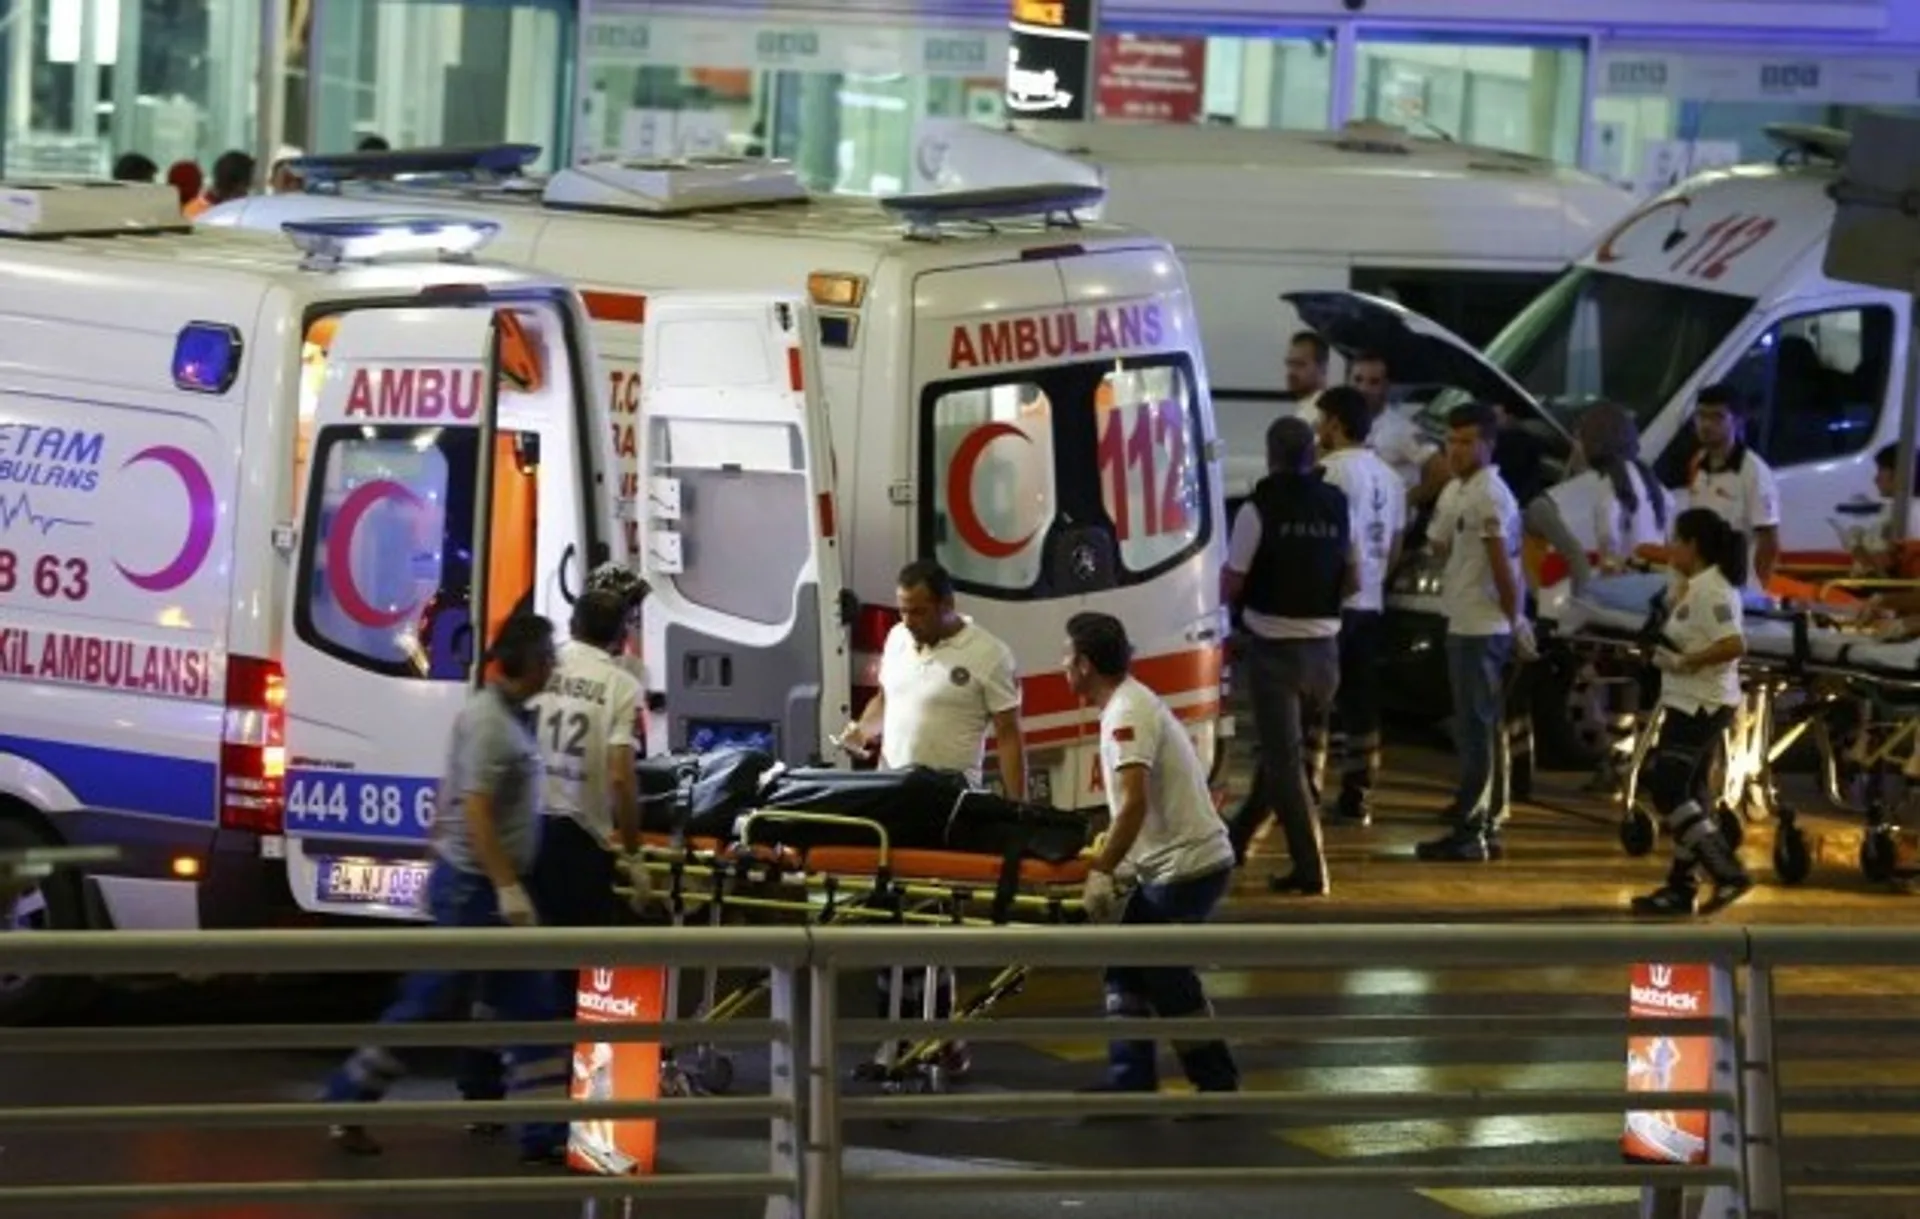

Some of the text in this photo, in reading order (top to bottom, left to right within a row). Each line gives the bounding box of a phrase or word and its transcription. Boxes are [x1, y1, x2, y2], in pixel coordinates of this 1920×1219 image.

[1669, 212, 1777, 280] 112
[949, 302, 1163, 369] AMBULANS
[345, 369, 481, 419] AMBU
[1099, 399, 1190, 542] 112
[35, 554, 88, 601] 63
[39, 632, 209, 697] AMBULANSI
[287, 779, 348, 823] 444
[359, 783, 403, 827] 88
